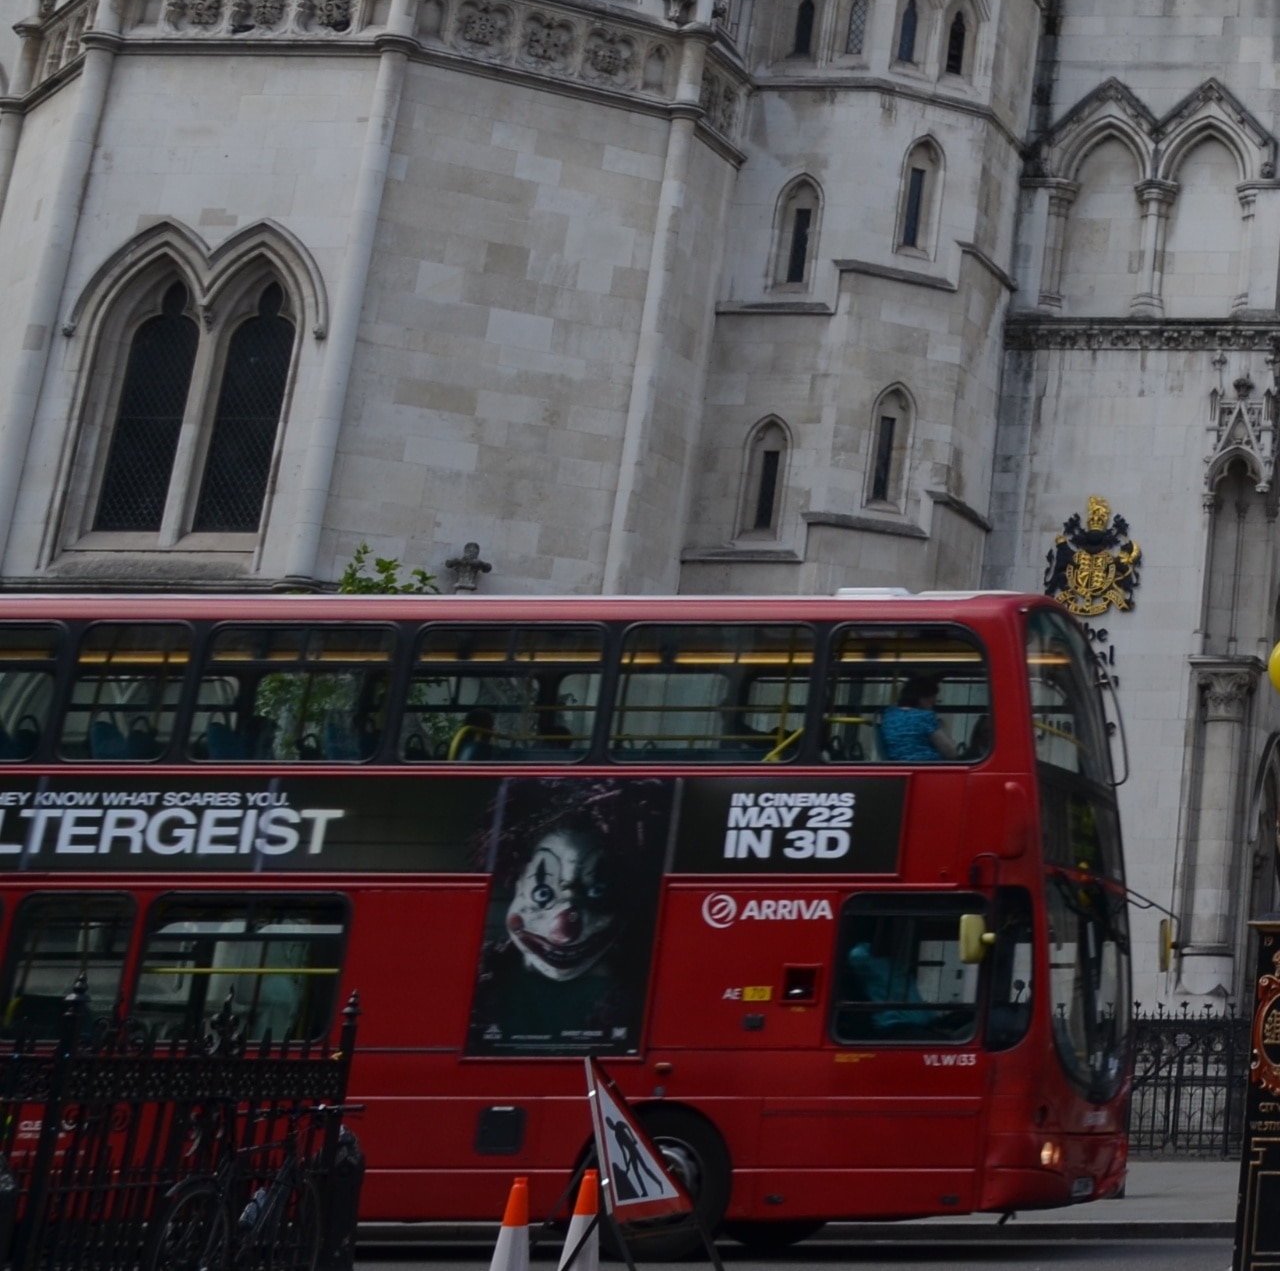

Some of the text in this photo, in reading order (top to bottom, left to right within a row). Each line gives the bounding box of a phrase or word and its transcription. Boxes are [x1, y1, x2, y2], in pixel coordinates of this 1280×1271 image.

[1081, 622, 1109, 642] he
[34, 792, 98, 806] KNOW
[102, 792, 158, 806] WHAT
[162, 791, 241, 806] SCARES
[246, 791, 290, 806] YOU.
[731, 792, 856, 807] IN CINEMAS
[727, 807, 854, 828] MAY 22
[723, 829, 851, 859] IN 3D
[740, 899, 834, 920] ARRIVA
[722, 988, 742, 1000] AE
